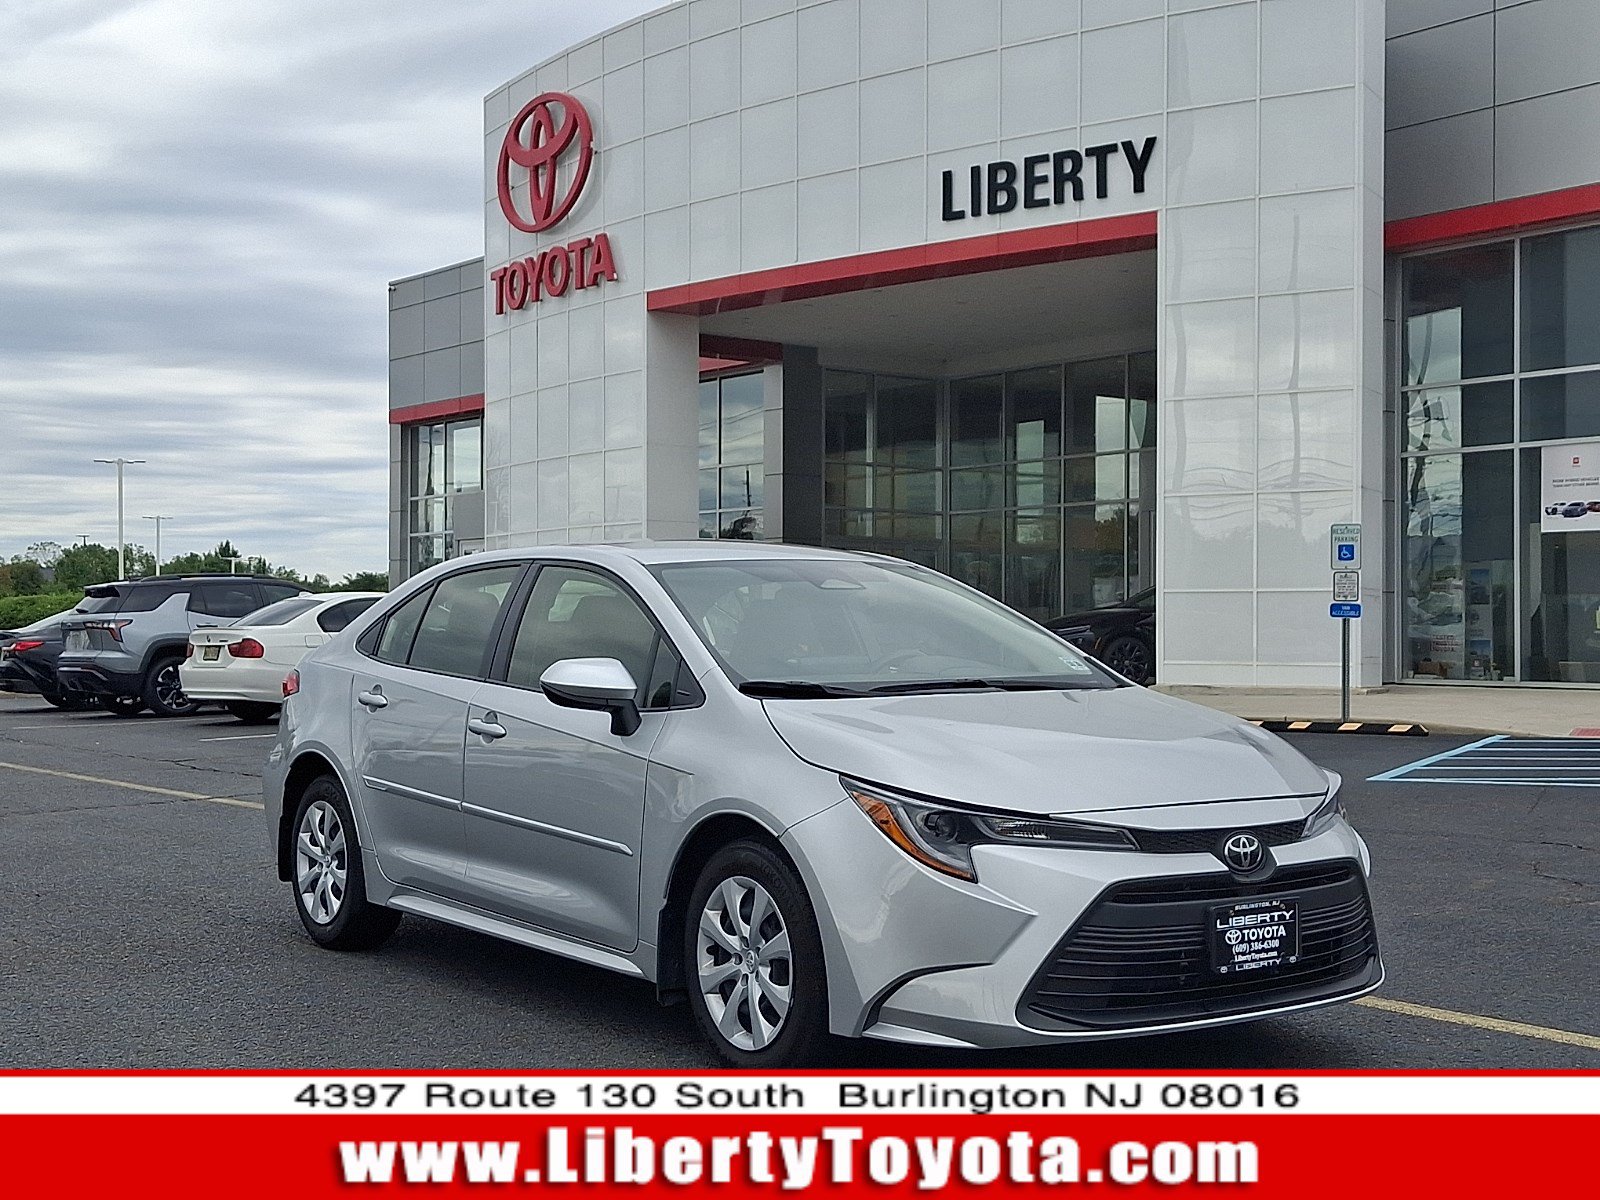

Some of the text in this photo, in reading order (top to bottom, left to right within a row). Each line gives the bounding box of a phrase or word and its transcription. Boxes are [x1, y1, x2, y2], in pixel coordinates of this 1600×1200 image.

[942, 136, 1157, 222] LIBERTY
[491, 233, 618, 315] TOYOTA
[1334, 535, 1359, 543] PARKING
[1216, 910, 1294, 928] LIBERTY
[1242, 925, 1286, 941] TOYOTA
[1232, 939, 1280, 955] (609) 386-6300
[1235, 958, 1281, 971] LIBERTY
